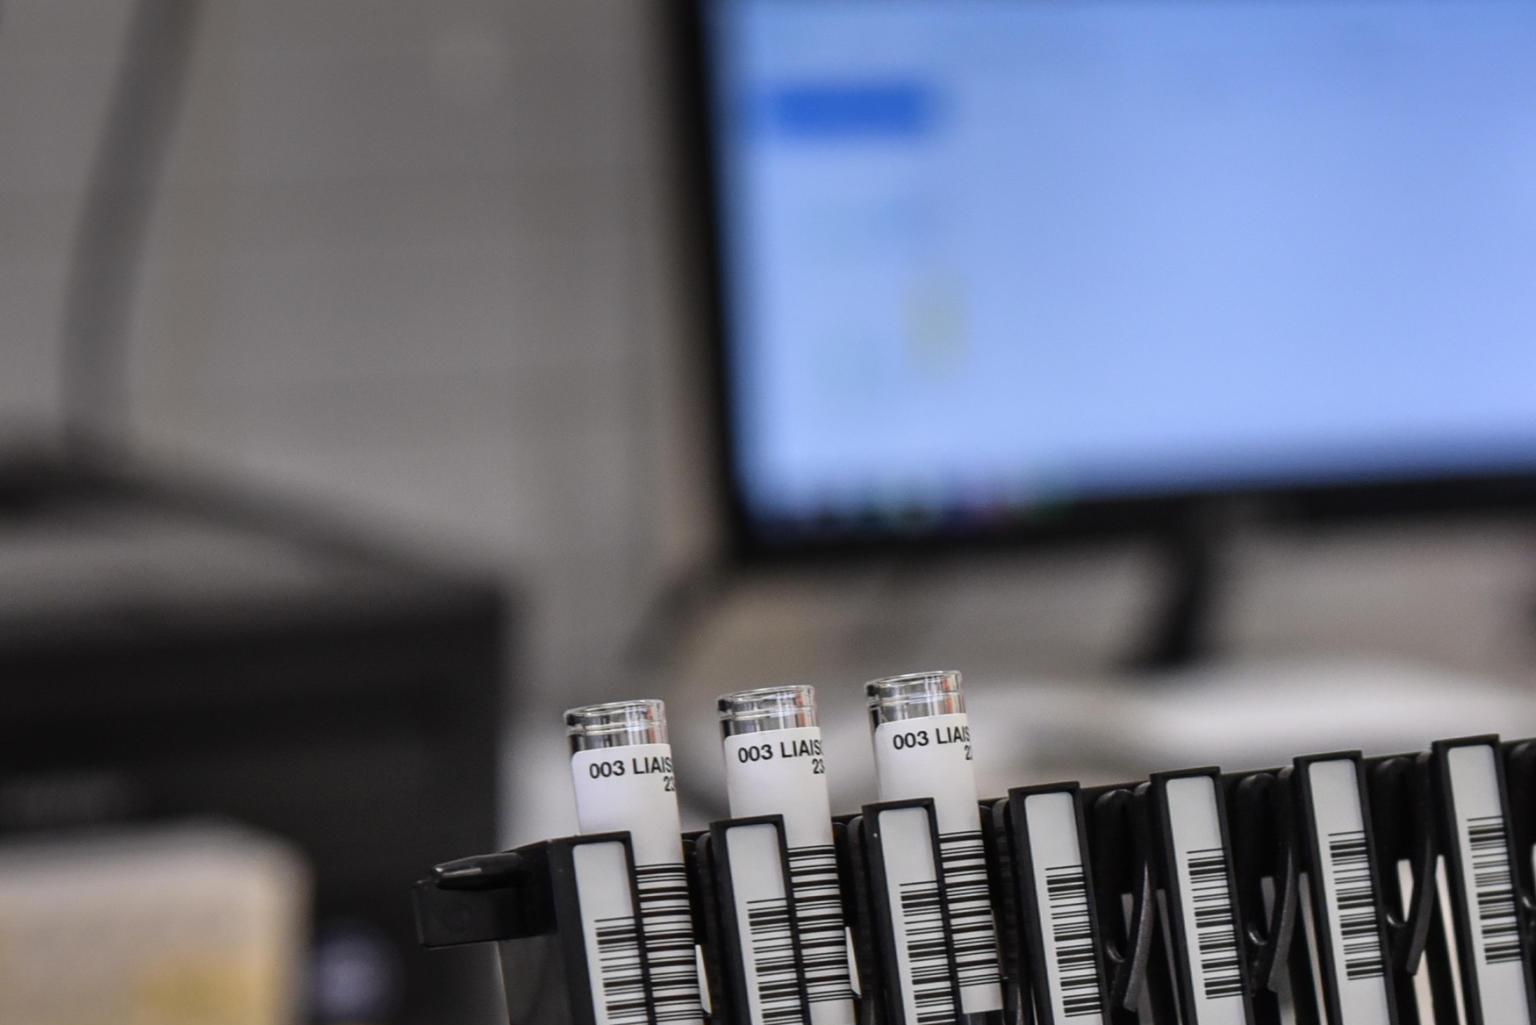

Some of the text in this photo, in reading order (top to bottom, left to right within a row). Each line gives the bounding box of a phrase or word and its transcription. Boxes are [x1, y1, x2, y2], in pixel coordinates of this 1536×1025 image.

[892, 730, 930, 750] 003
[738, 743, 774, 764] 003
[589, 759, 626, 779] 003
